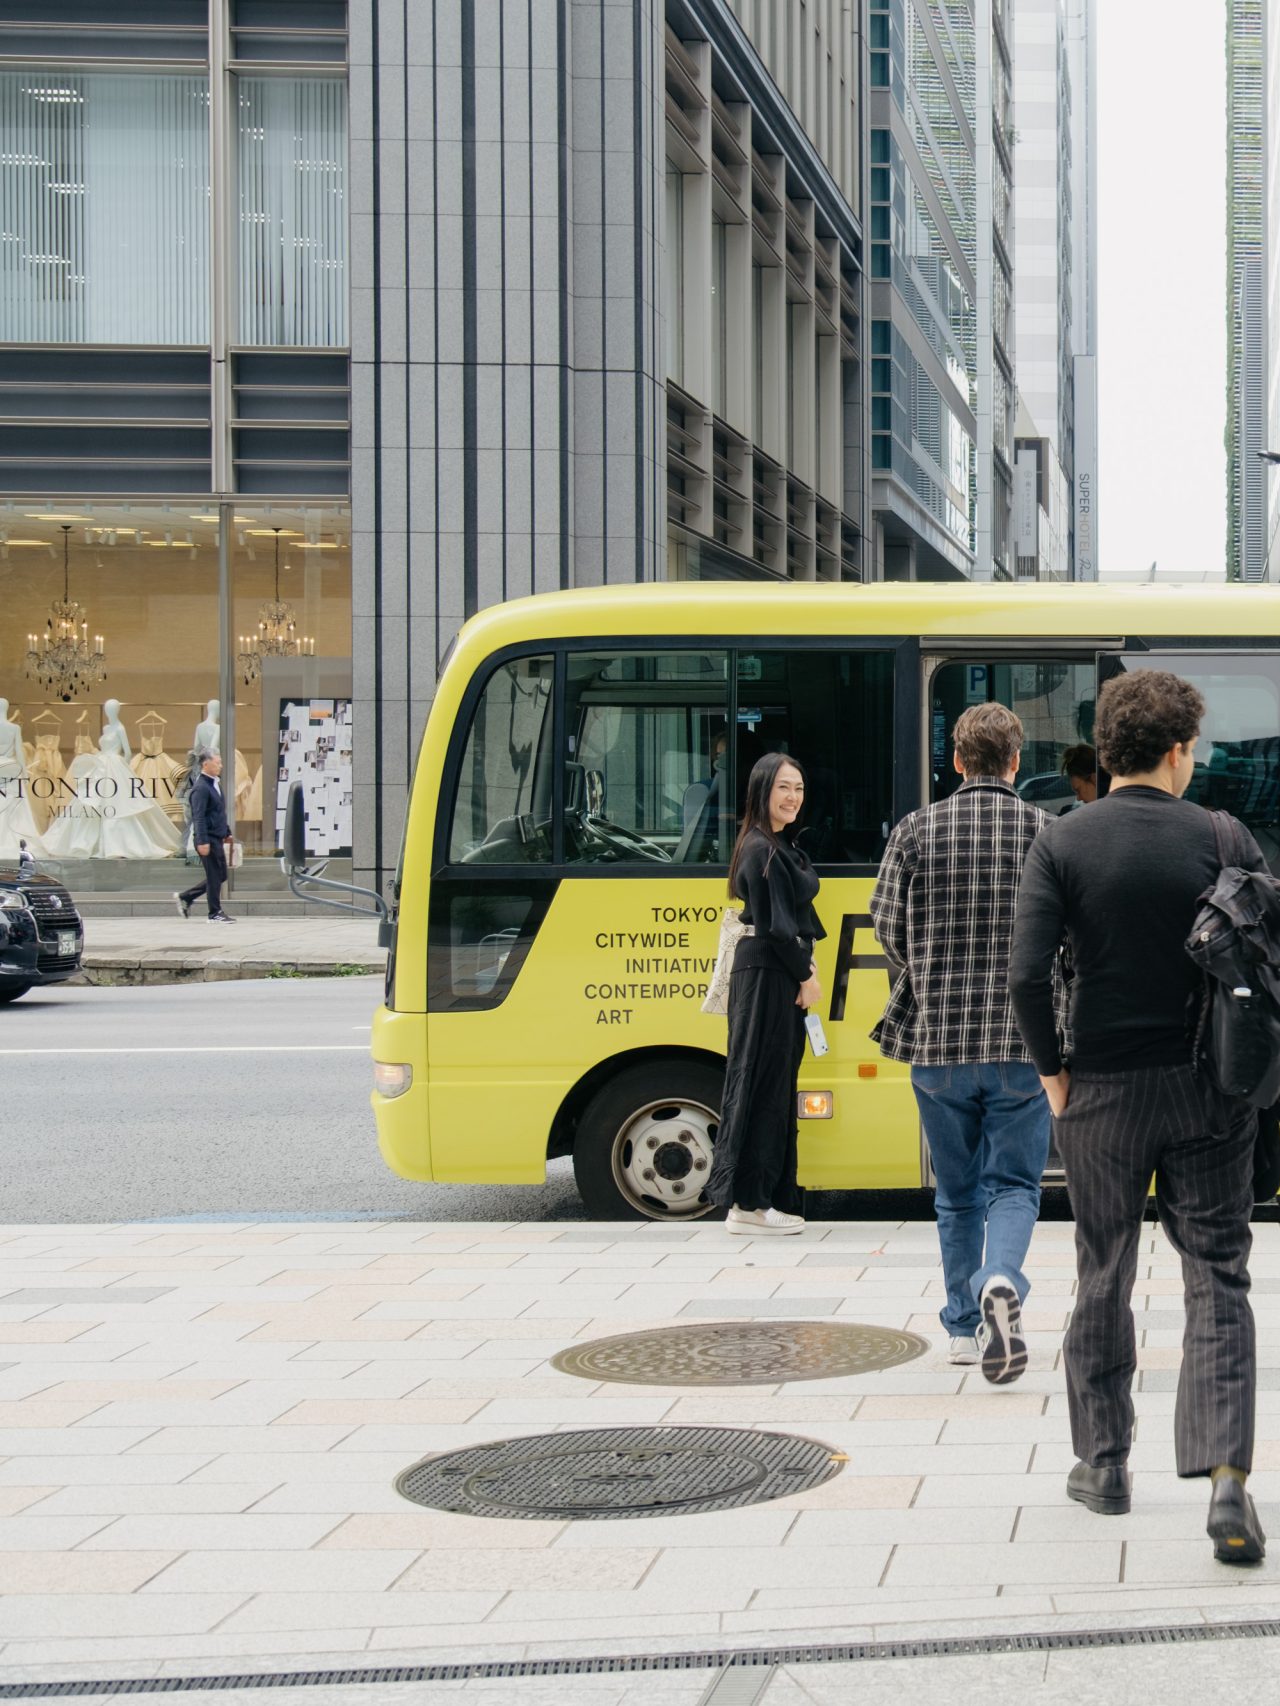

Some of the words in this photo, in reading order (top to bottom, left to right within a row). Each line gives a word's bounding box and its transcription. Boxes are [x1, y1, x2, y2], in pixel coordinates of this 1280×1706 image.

[48, 804, 117, 819] MILANO
[651, 906, 723, 923] TOKYO'
[595, 932, 690, 949] CITYWIDE
[584, 983, 709, 1000] CONTEMPOR
[596, 1008, 634, 1025] ART
